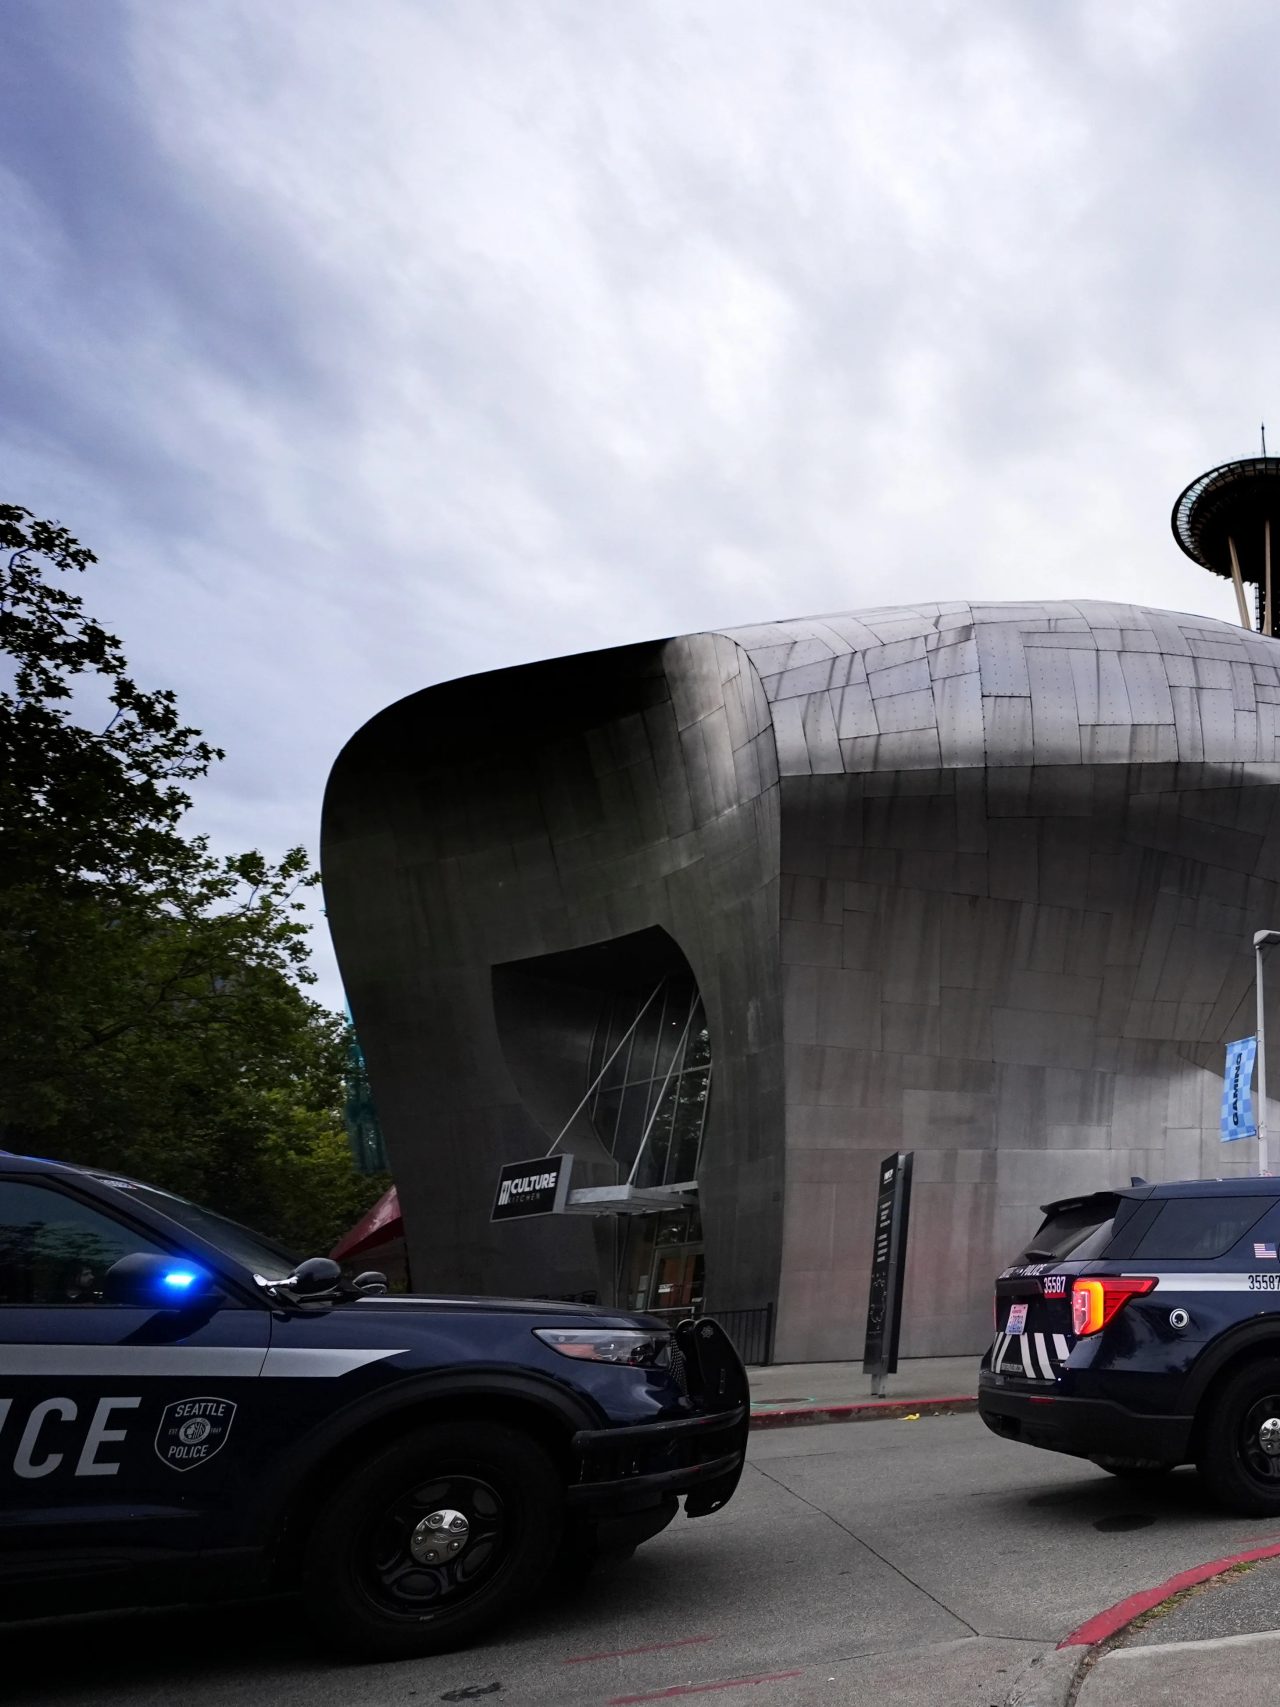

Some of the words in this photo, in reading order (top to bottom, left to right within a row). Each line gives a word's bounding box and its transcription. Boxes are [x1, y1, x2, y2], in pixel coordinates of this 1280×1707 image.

[1232, 1053, 1242, 1126] GAMING
[511, 1172, 557, 1194] CULTURE
[1044, 1276, 1066, 1293] 35587
[1248, 1275, 1280, 1290] 35587
[175, 1402, 226, 1417] SEATTLE
[0, 1397, 142, 1479] CE
[168, 1445, 209, 1459] POLICE
